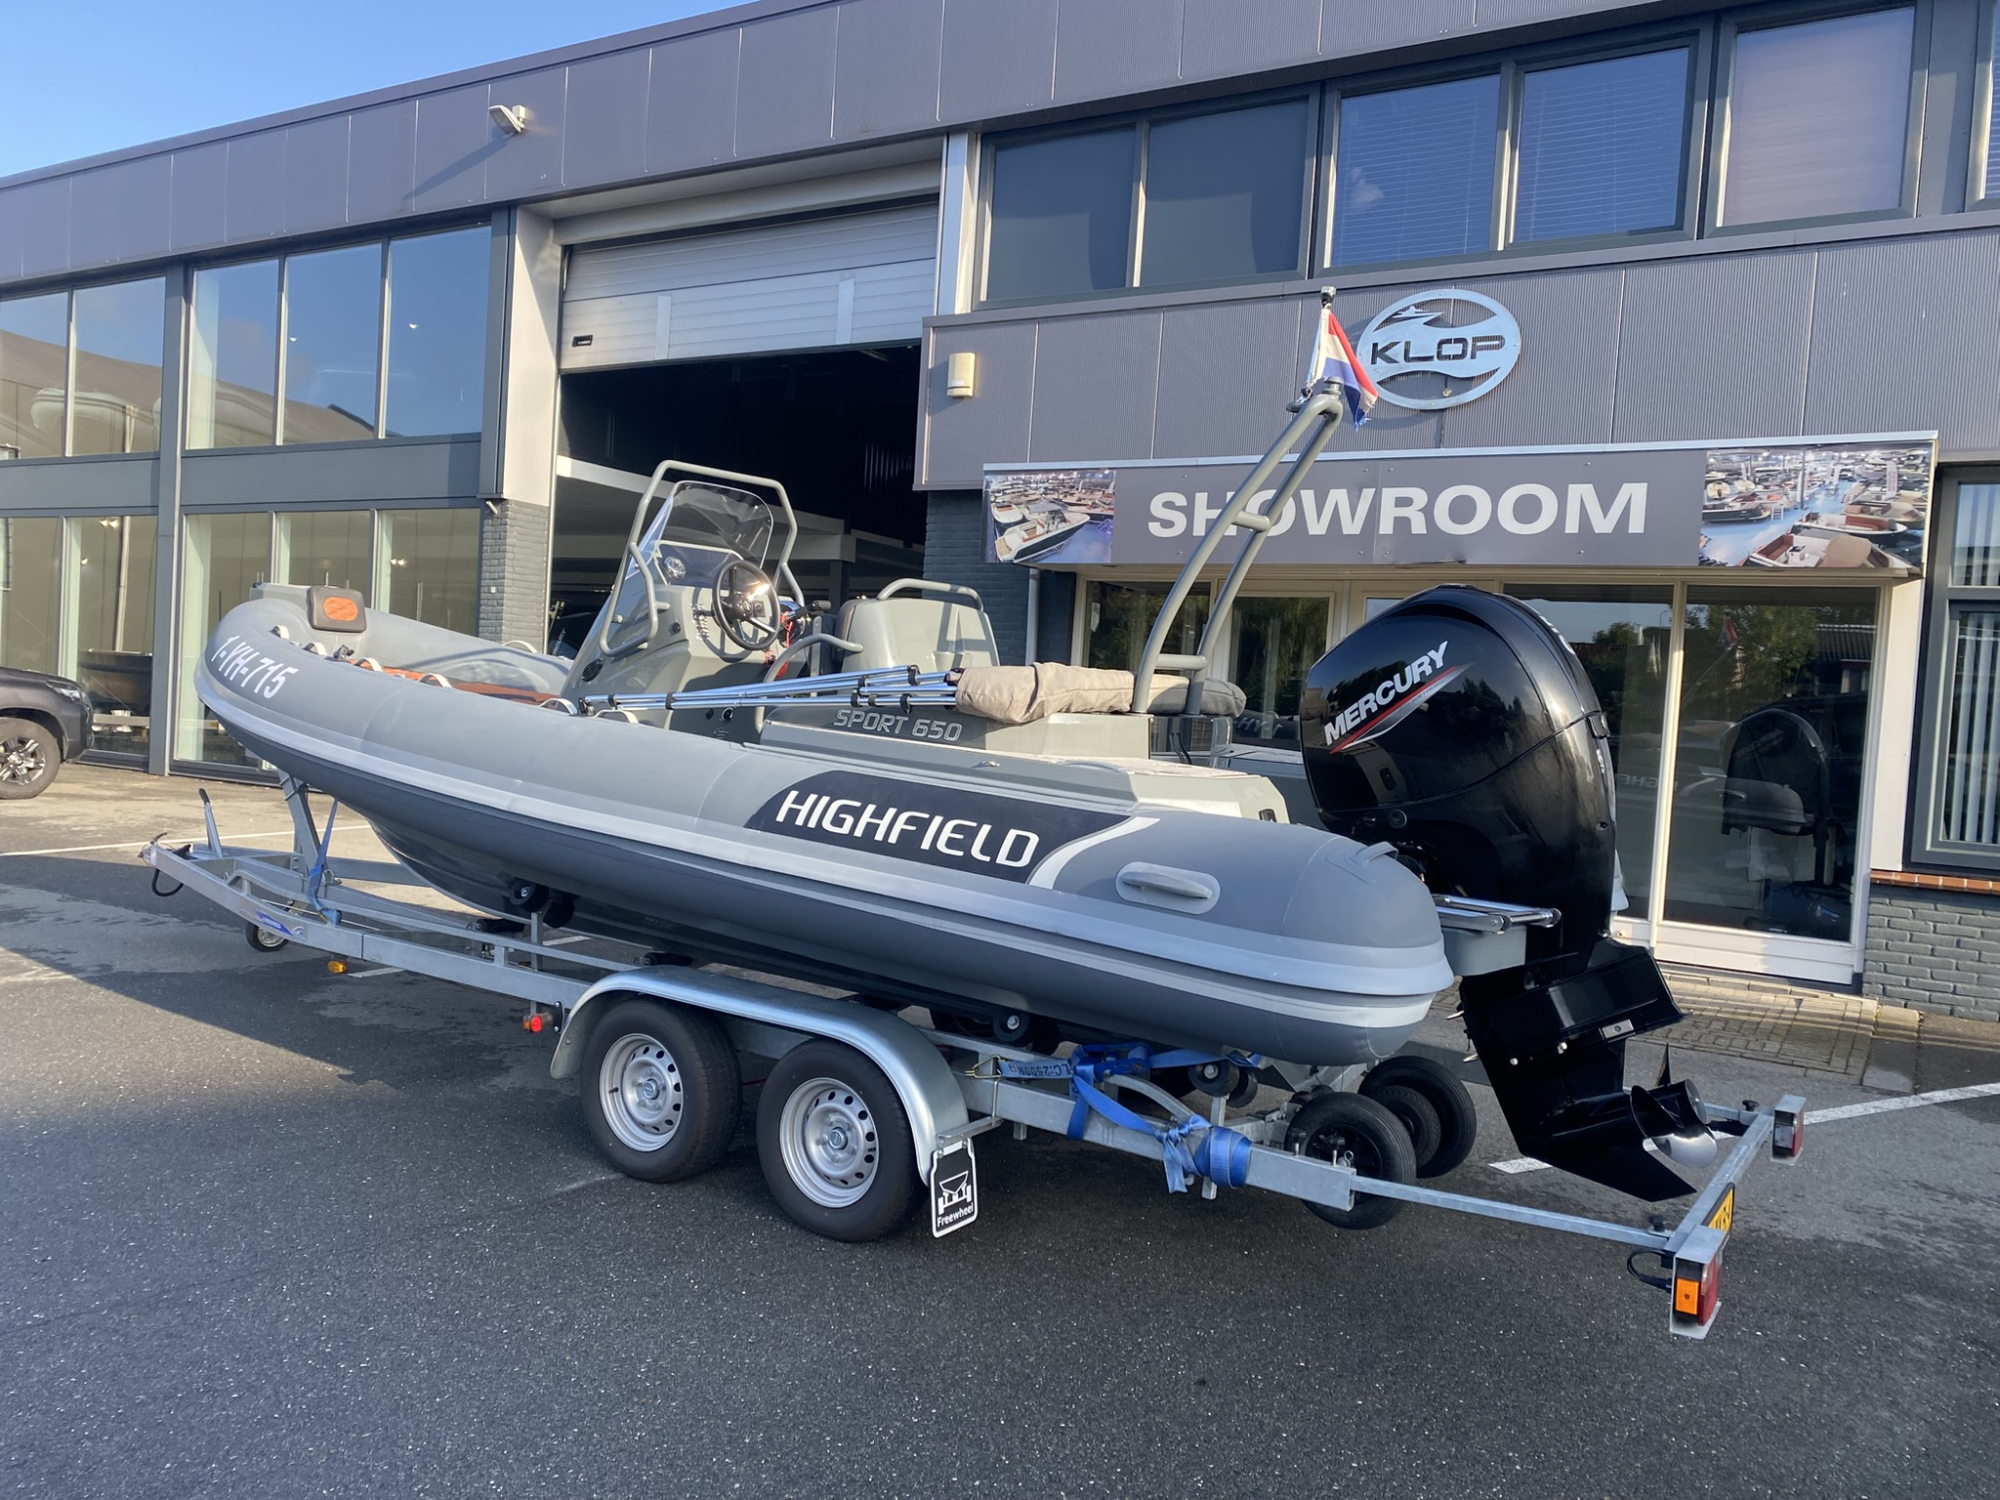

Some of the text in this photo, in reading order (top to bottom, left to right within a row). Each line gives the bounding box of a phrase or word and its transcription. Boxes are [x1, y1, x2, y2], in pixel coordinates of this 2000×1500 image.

[1370, 334, 1506, 365] KLOP
[1147, 482, 1648, 538] SHOWROOM
[211, 635, 299, 699] 1-YH-715
[1324, 640, 1449, 746] MERCURY
[833, 708, 963, 741] SPORT 650
[775, 790, 1040, 868] HIGHFIELD
[936, 1202, 974, 1228] Freewheel
